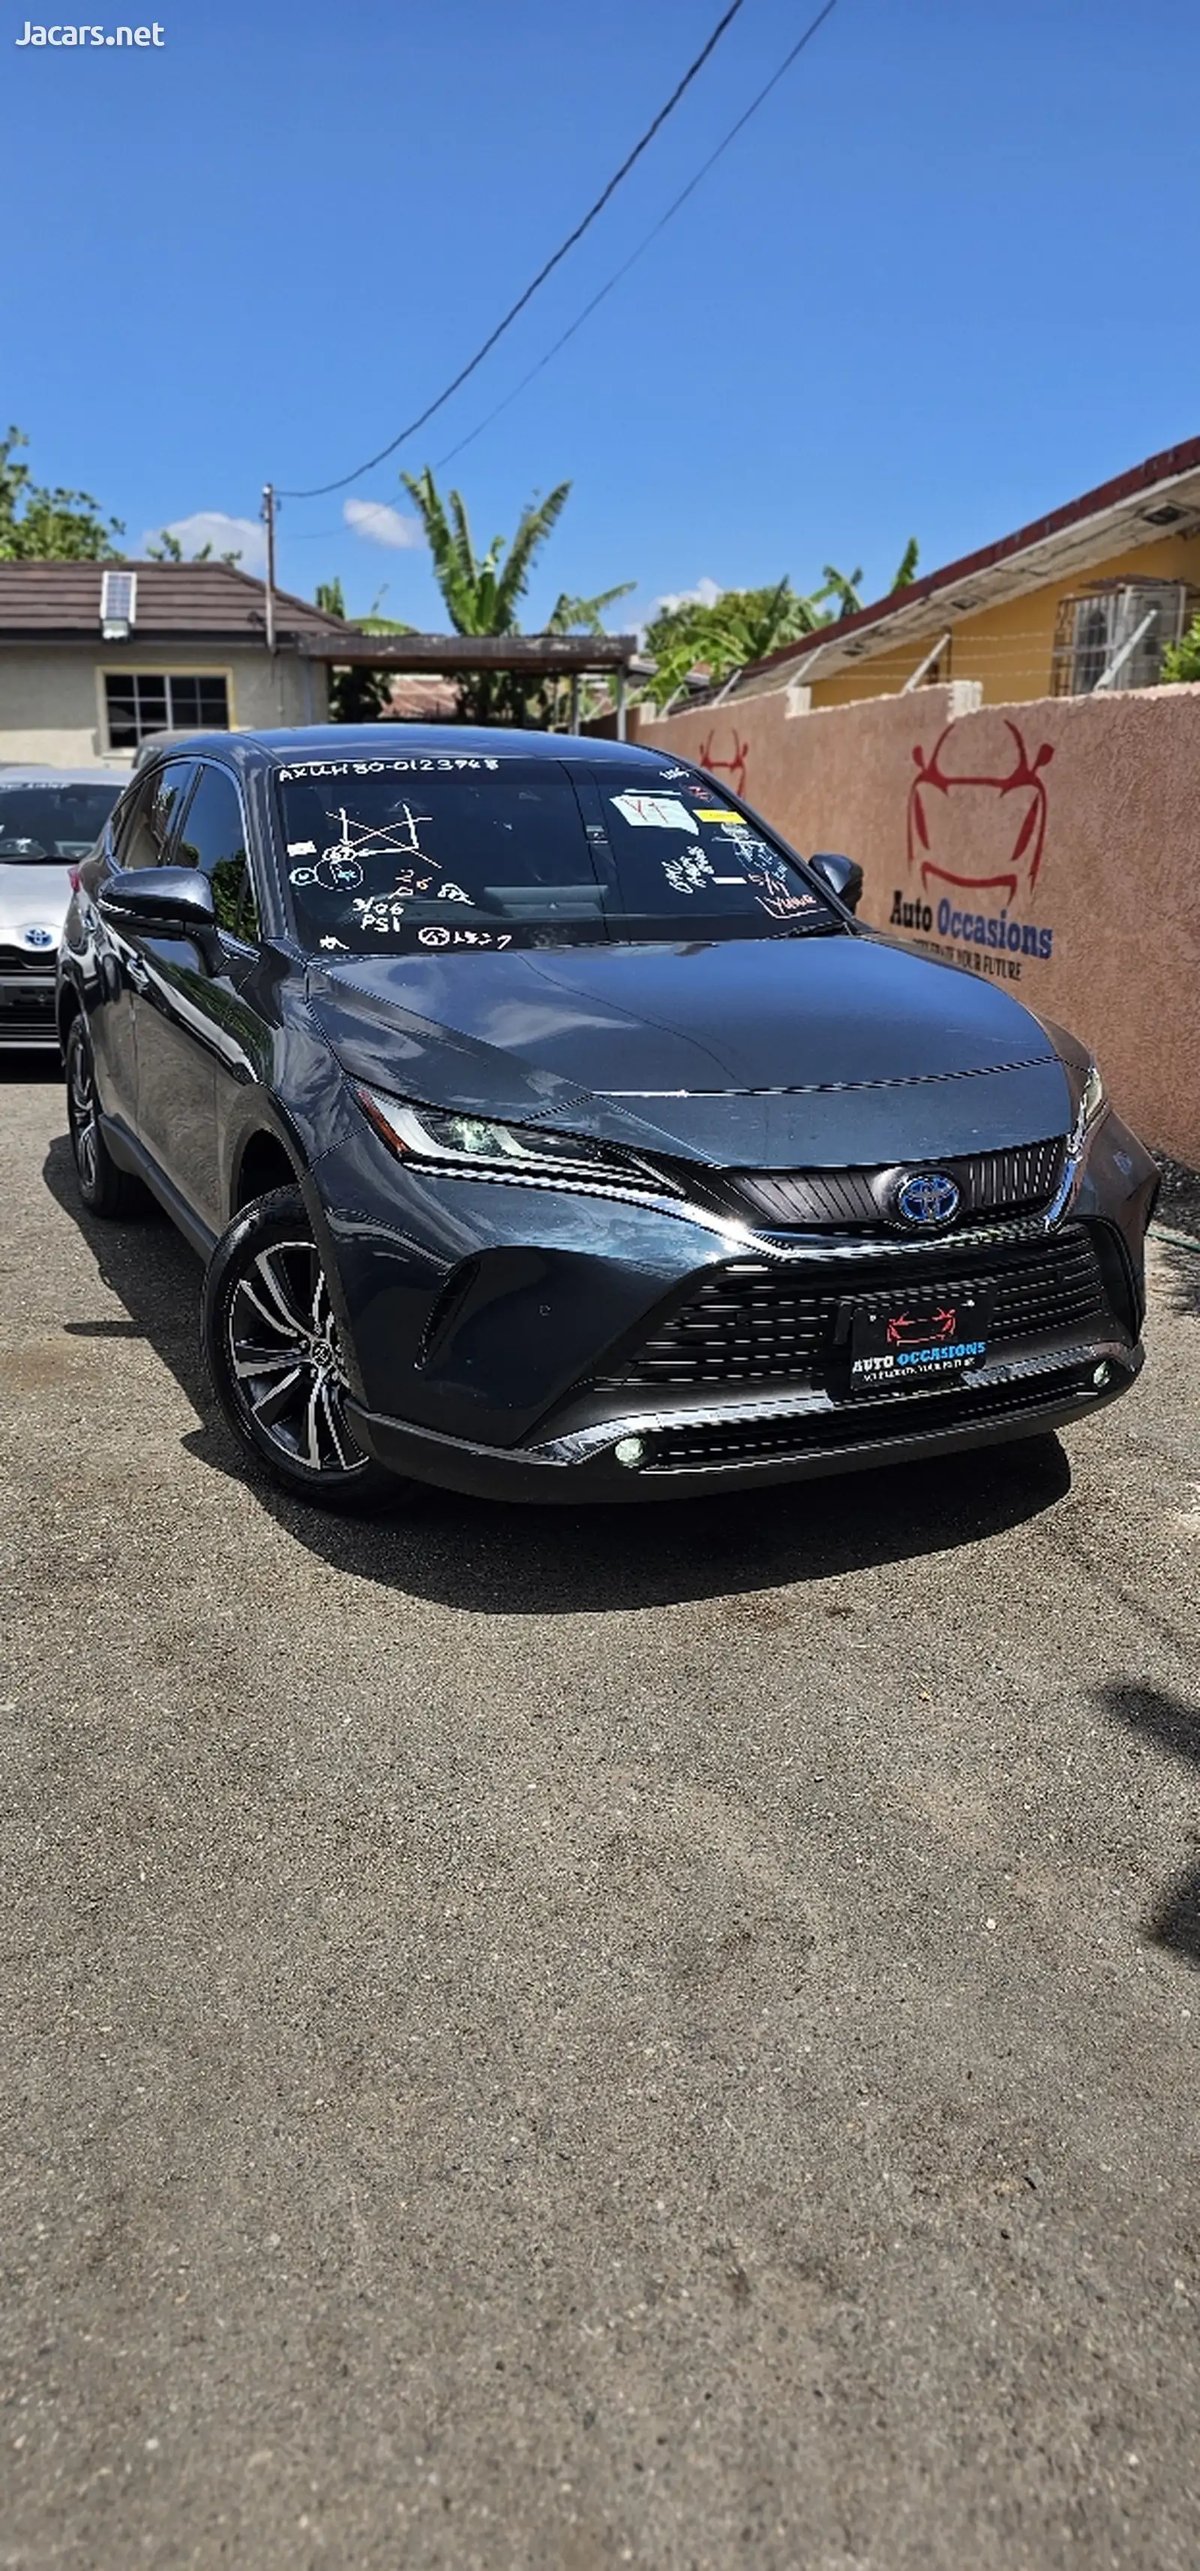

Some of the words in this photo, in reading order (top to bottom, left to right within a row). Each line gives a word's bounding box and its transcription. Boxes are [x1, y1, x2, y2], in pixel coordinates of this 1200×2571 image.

[890, 890, 933, 932] Auto
[937, 898, 1053, 960] Occasions
[983, 955, 1022, 982] FUTURE
[852, 1355, 895, 1374] AUTO
[897, 1341, 987, 1367] OCCASIONS
